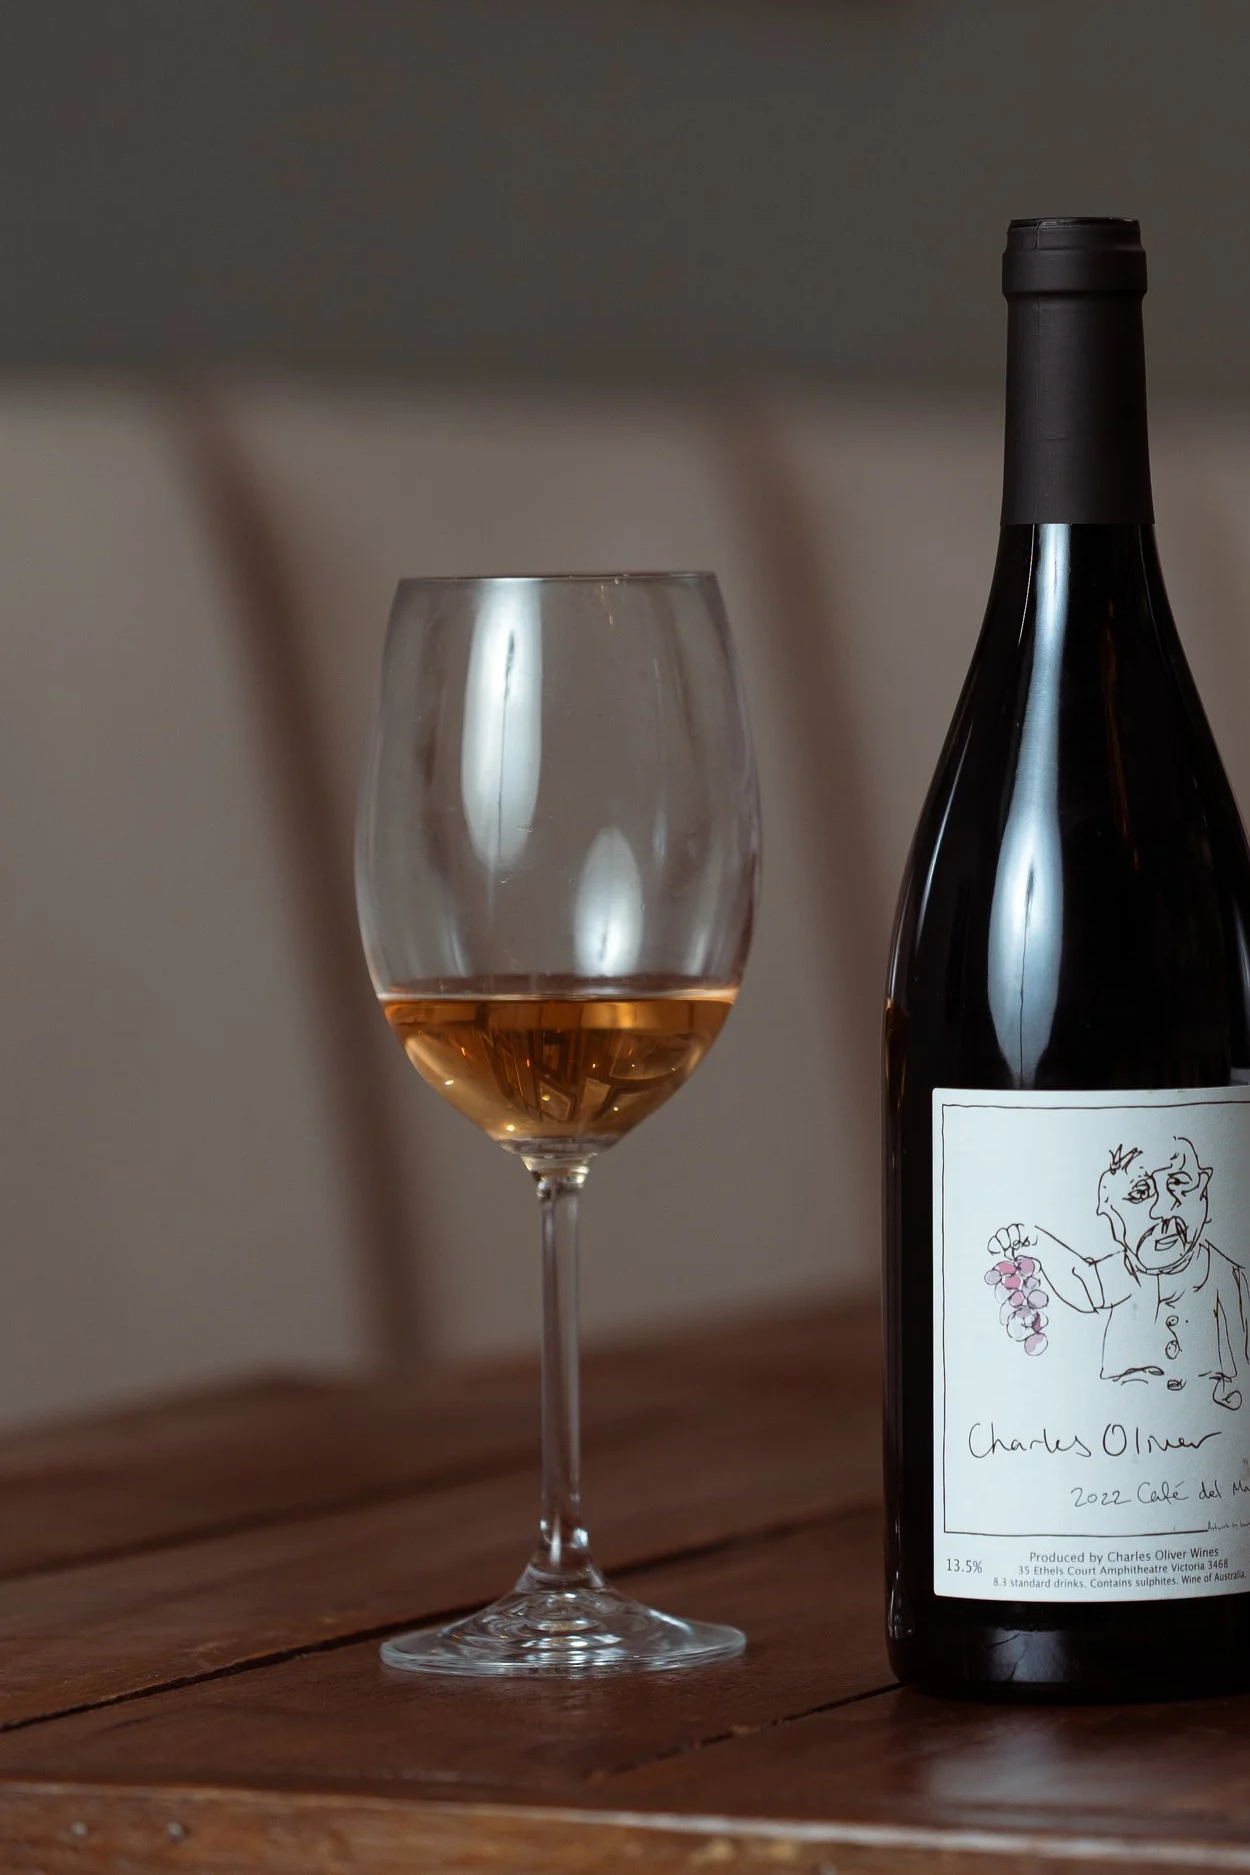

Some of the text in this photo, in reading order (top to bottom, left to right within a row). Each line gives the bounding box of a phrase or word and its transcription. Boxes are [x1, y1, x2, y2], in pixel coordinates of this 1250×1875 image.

[968, 1422, 1222, 1459] Charles Oliver
[1070, 1486, 1132, 1508] 2022
[1137, 1481, 1188, 1506] Café
[1198, 1479, 1222, 1500] del
[1029, 1547, 1219, 1565] Produced by Charles Oliver Wines
[946, 1558, 983, 1574] 13.5%
[1018, 1559, 1229, 1577] 35 Ethels Court Amphitheatre Victoria 3468
[993, 1571, 1247, 1589] 8.3 standard drinks. Contains sulphites. Wine of Australia.
